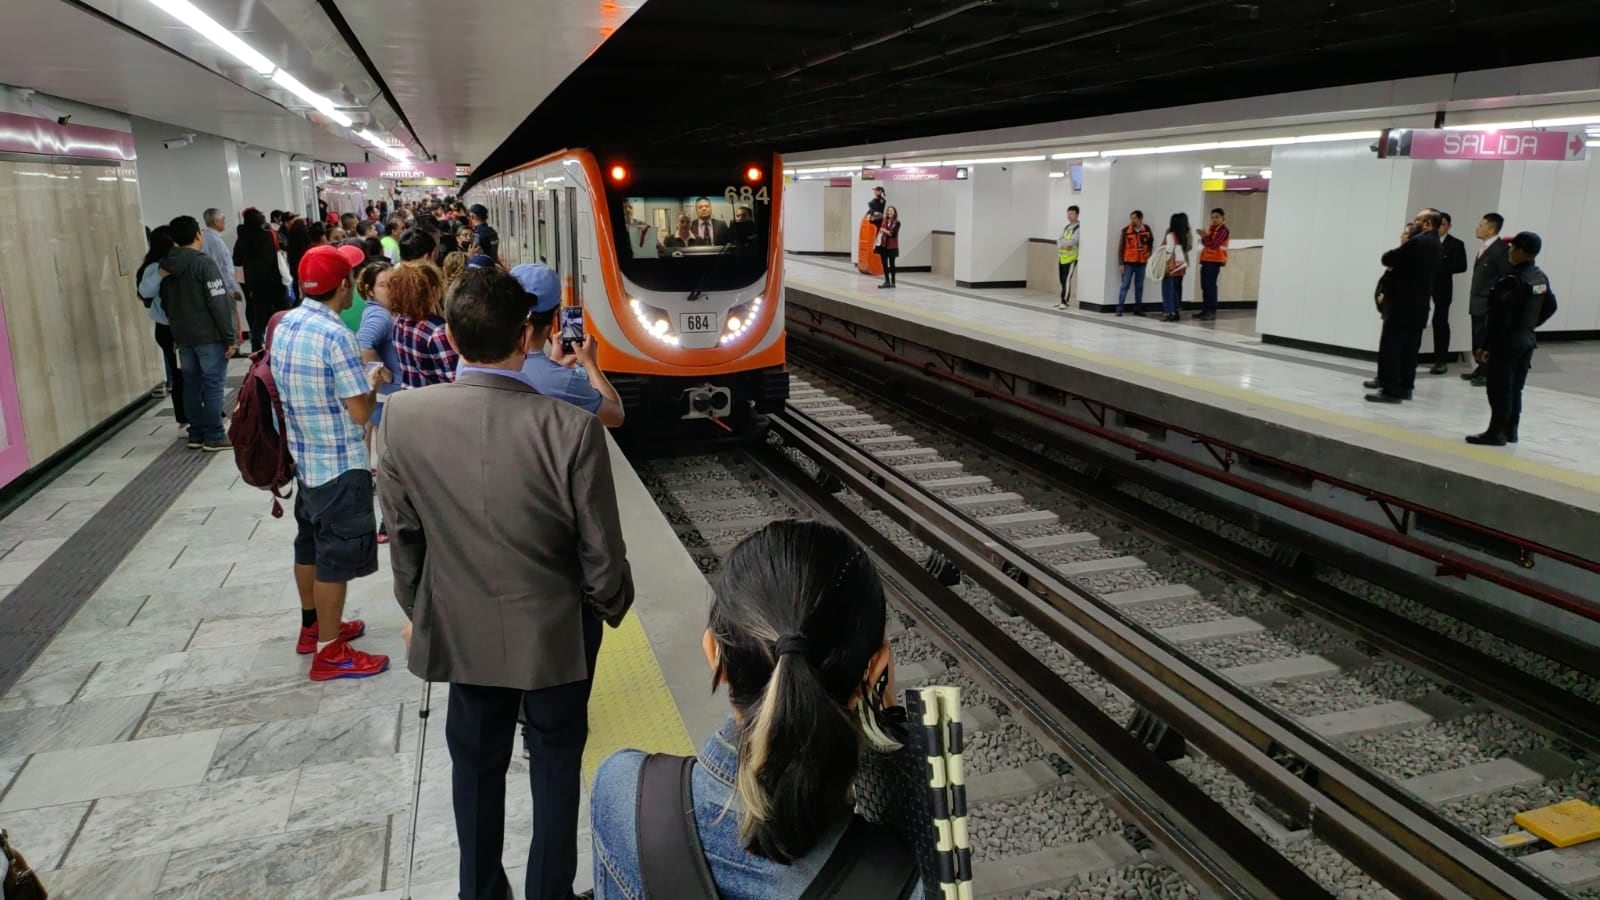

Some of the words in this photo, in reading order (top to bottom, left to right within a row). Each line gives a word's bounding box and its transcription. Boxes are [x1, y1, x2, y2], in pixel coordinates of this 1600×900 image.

[1443, 133, 1538, 156] SALIDA
[724, 185, 770, 206] 684
[687, 315, 709, 330] 684
